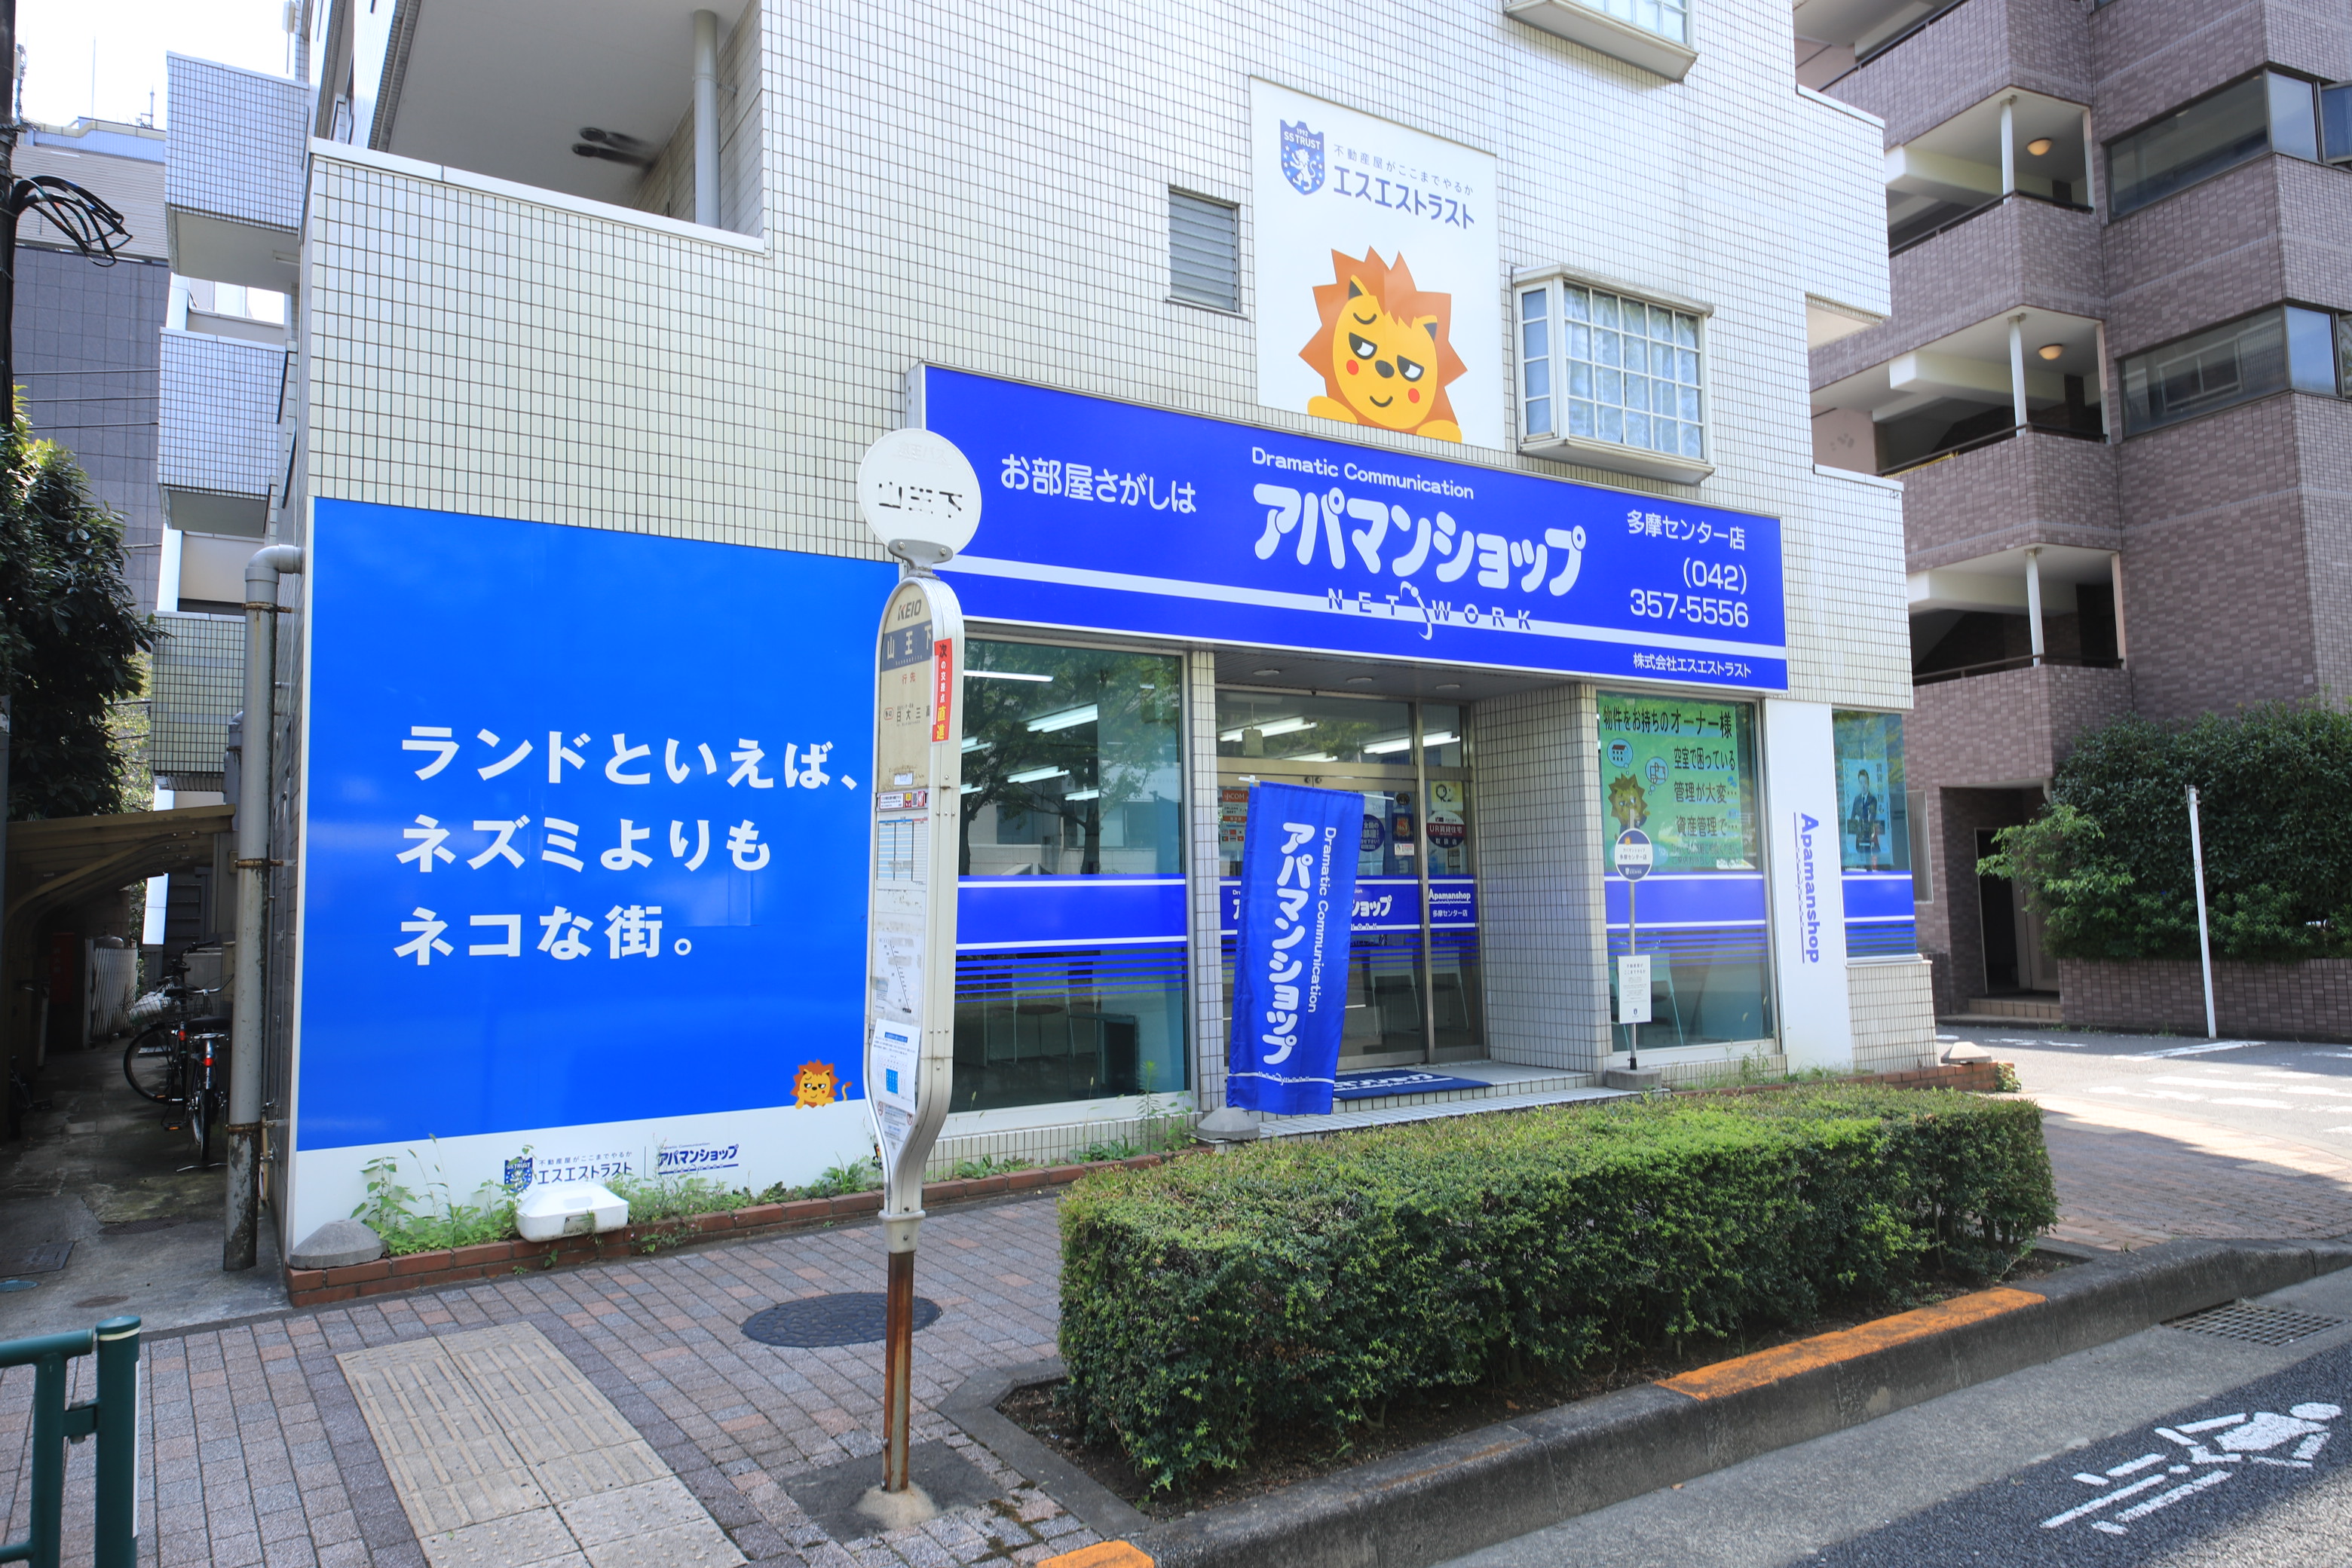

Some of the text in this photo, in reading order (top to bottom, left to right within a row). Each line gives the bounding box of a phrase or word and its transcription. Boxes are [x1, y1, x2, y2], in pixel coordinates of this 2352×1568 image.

[1334, 143, 1474, 197] 不動産屋がここまでやるか
[1334, 165, 1475, 230] エスエストラスト
[1000, 454, 1197, 514] お部屋さがしは
[1251, 447, 1475, 500] Dramatic Communication
[1253, 483, 1586, 596] アパマンショップ
[1627, 510, 1746, 551] 多摩センター店
[1682, 558, 1748, 595] (042)
[898, 599, 921, 620] KEIO
[1630, 590, 1750, 628] 357-5556
[887, 624, 932, 660] 山王下
[1633, 652, 1753, 678] 株式会社エスエストラスト
[1603, 705, 1732, 739] 物件をお持ちのオーナー様
[402, 725, 858, 791] ランドといえば、
[1674, 746, 1735, 770] 空室で困っている
[396, 814, 771, 873] ネズミよりも
[1429, 888, 1472, 901] Apamanshop
[1800, 813, 1821, 963] Apamanshop
[1307, 826, 1337, 1014] Dramatic Communication
[1432, 909, 1468, 917] 多摩センター店
[394, 905, 692, 966] ネコな街。
[1262, 822, 1315, 1064] アパマンショップ
[537, 1162, 632, 1185] エスエストラスト
[538, 1151, 632, 1167] 不動産屋がここまでやるか
[658, 1144, 740, 1167] アパマンショップ
